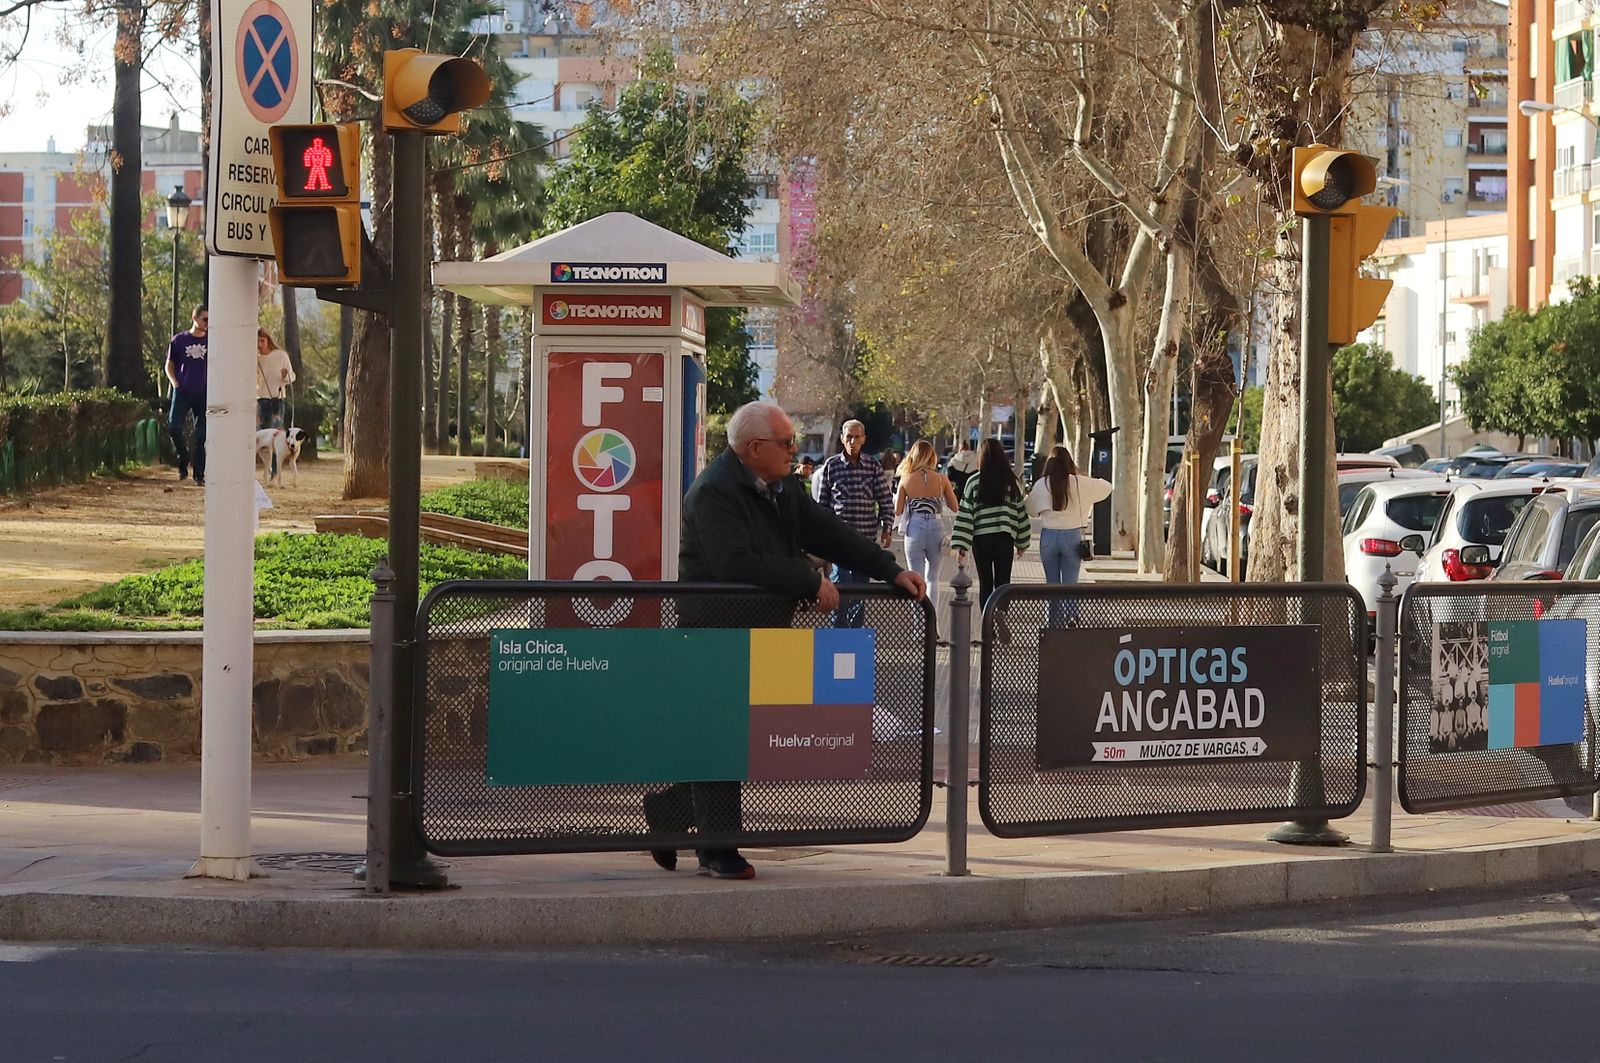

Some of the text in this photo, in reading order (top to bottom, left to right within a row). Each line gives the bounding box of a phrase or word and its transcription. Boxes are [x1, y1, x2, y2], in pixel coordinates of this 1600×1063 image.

[244, 136, 273, 156] CAR
[228, 163, 278, 186] RESERV
[227, 221, 267, 241] BUS Y
[572, 266, 664, 281] TECNOTRON
[568, 304, 663, 319] TECNOTRON
[1099, 450, 1108, 462] P
[499, 640, 568, 656] Isla Chica,
[498, 657, 609, 675] original de Huelva
[1094, 687, 1266, 733] ANGABAD
[1103, 746, 1126, 760] 50m
[1139, 741, 1181, 758] MUÑOZ
[1184, 743, 1200, 757] DE
[1251, 741, 1260, 754] 4
